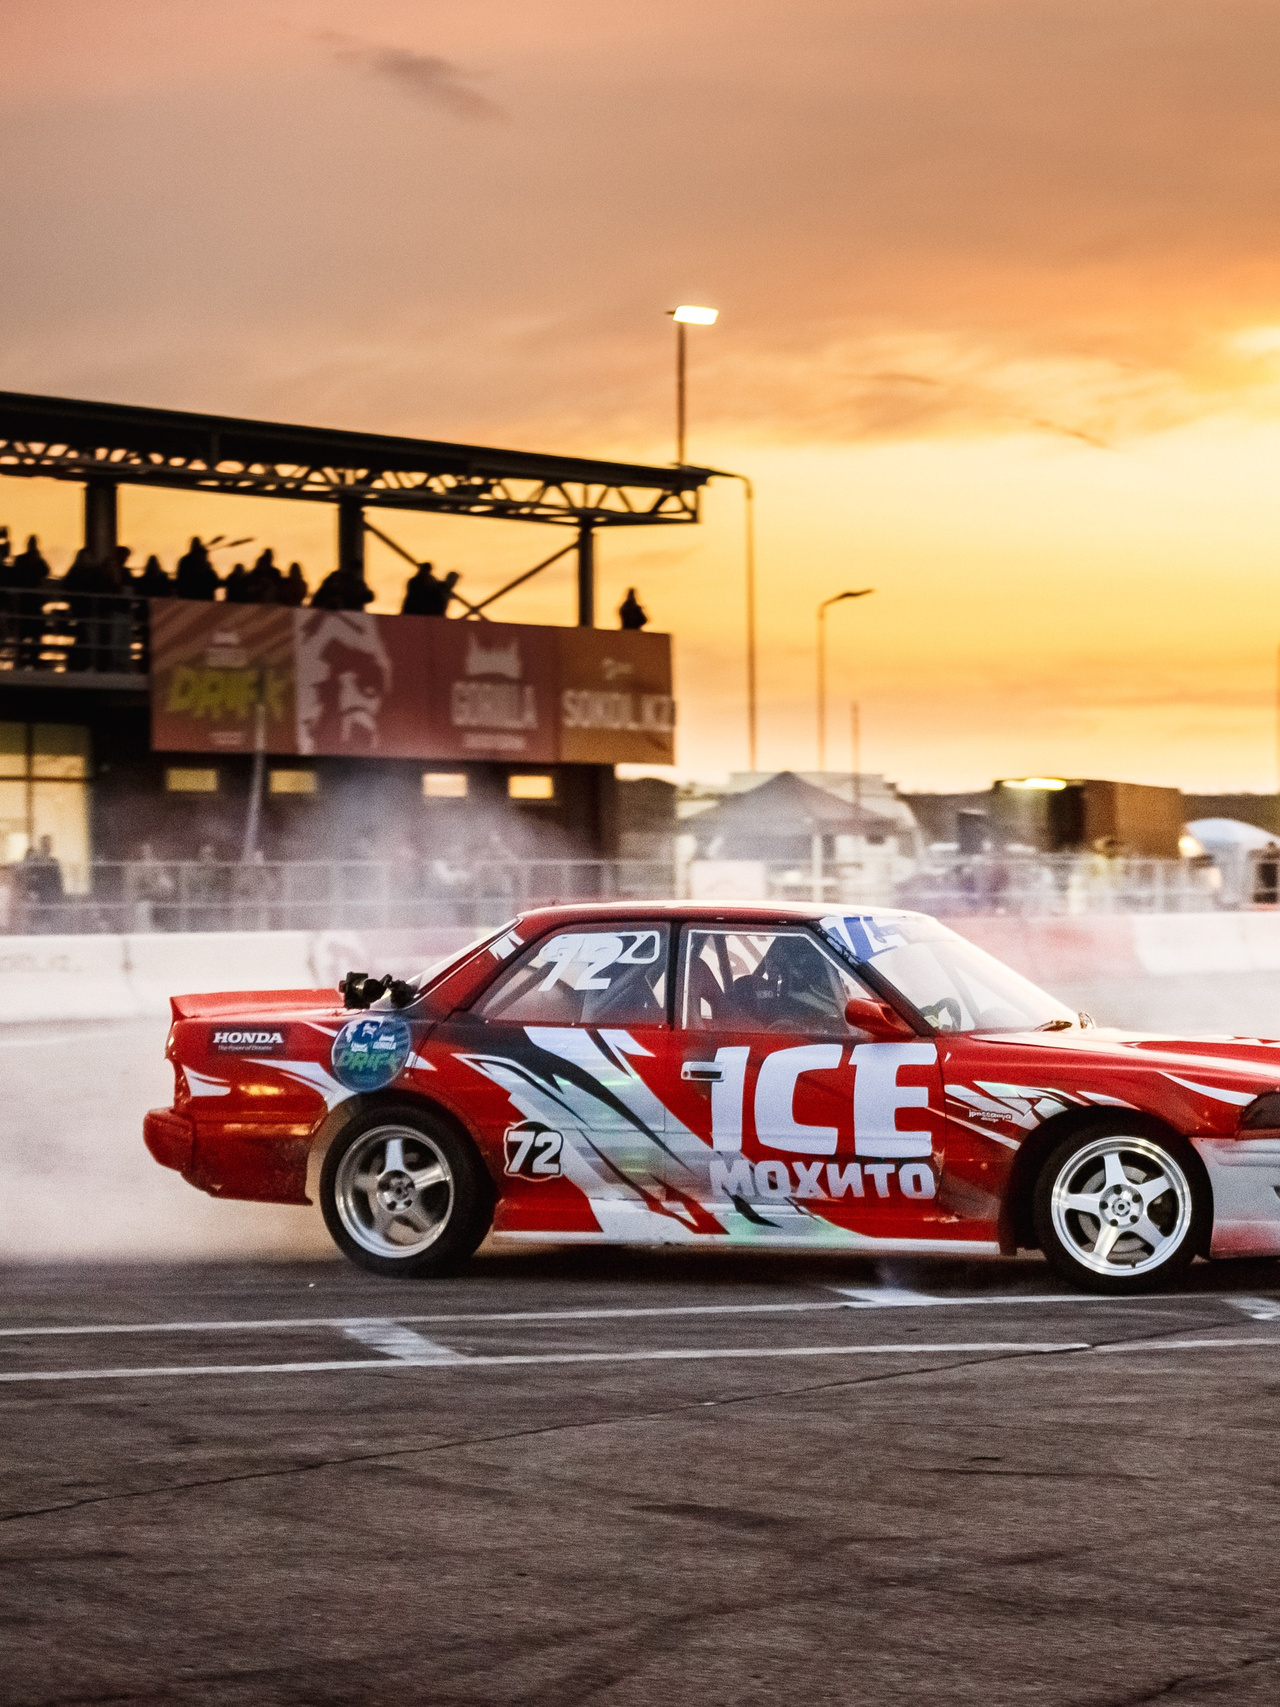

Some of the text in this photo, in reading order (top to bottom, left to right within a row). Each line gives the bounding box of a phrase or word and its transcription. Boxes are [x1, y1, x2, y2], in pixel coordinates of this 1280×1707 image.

[212, 1031, 284, 1044] HONDA
[711, 1043, 938, 1158] ICE
[508, 1131, 561, 1173] 72
